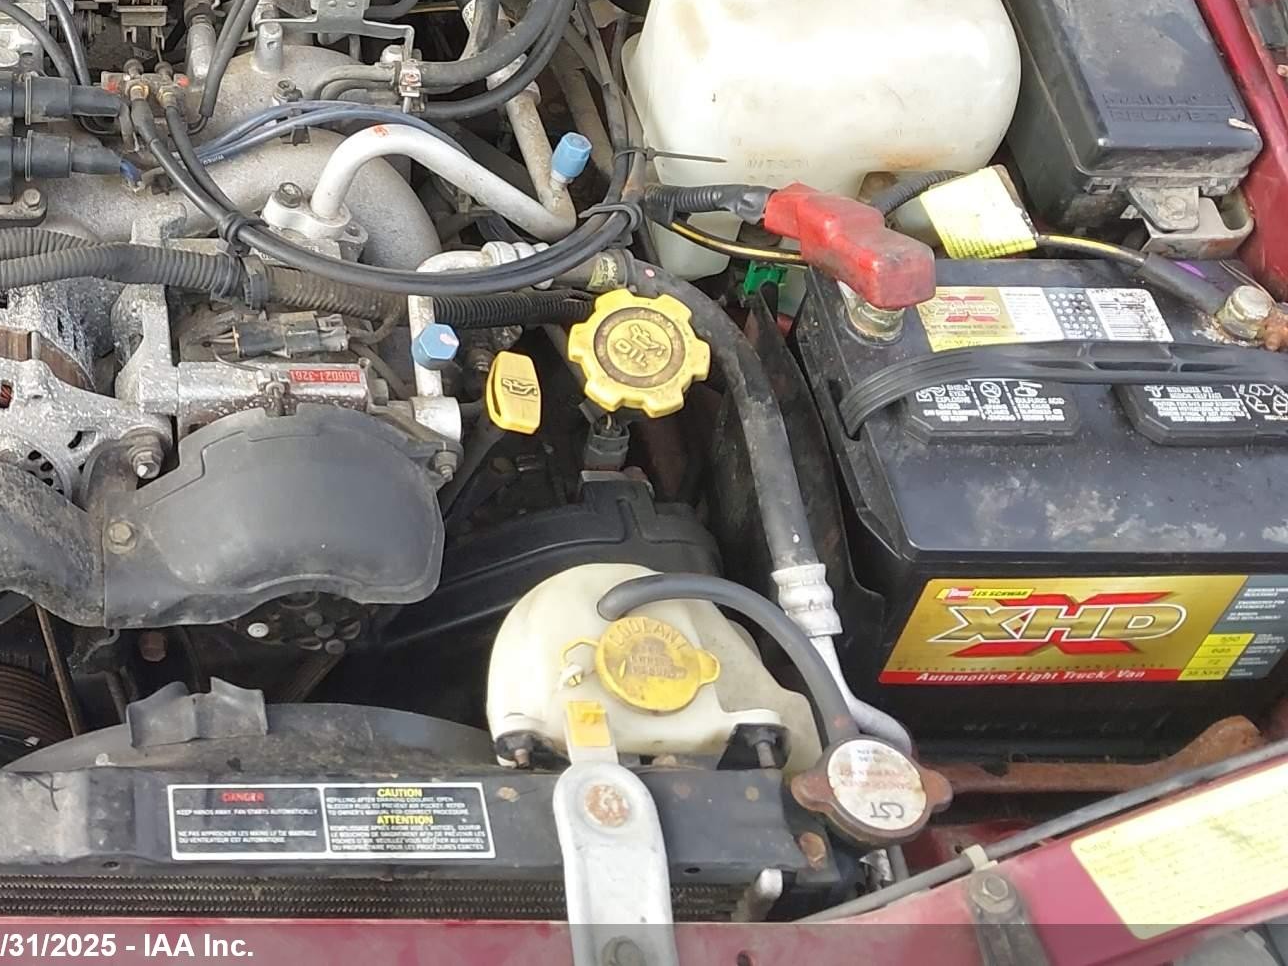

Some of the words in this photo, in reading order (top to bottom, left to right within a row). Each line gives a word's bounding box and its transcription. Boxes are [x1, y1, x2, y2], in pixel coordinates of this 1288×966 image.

[615, 338, 648, 368] OIL
[926, 603, 1187, 643] XHD
[916, 671, 1012, 682] Automotive/
[1017, 671, 1059, 682] Light
[1064, 669, 1113, 681] Truck/
[1117, 670, 1145, 679] Van
[221, 792, 264, 802] DANGER
[377, 789, 423, 797] CAUTION
[376, 815, 433, 825] ATTENTION
